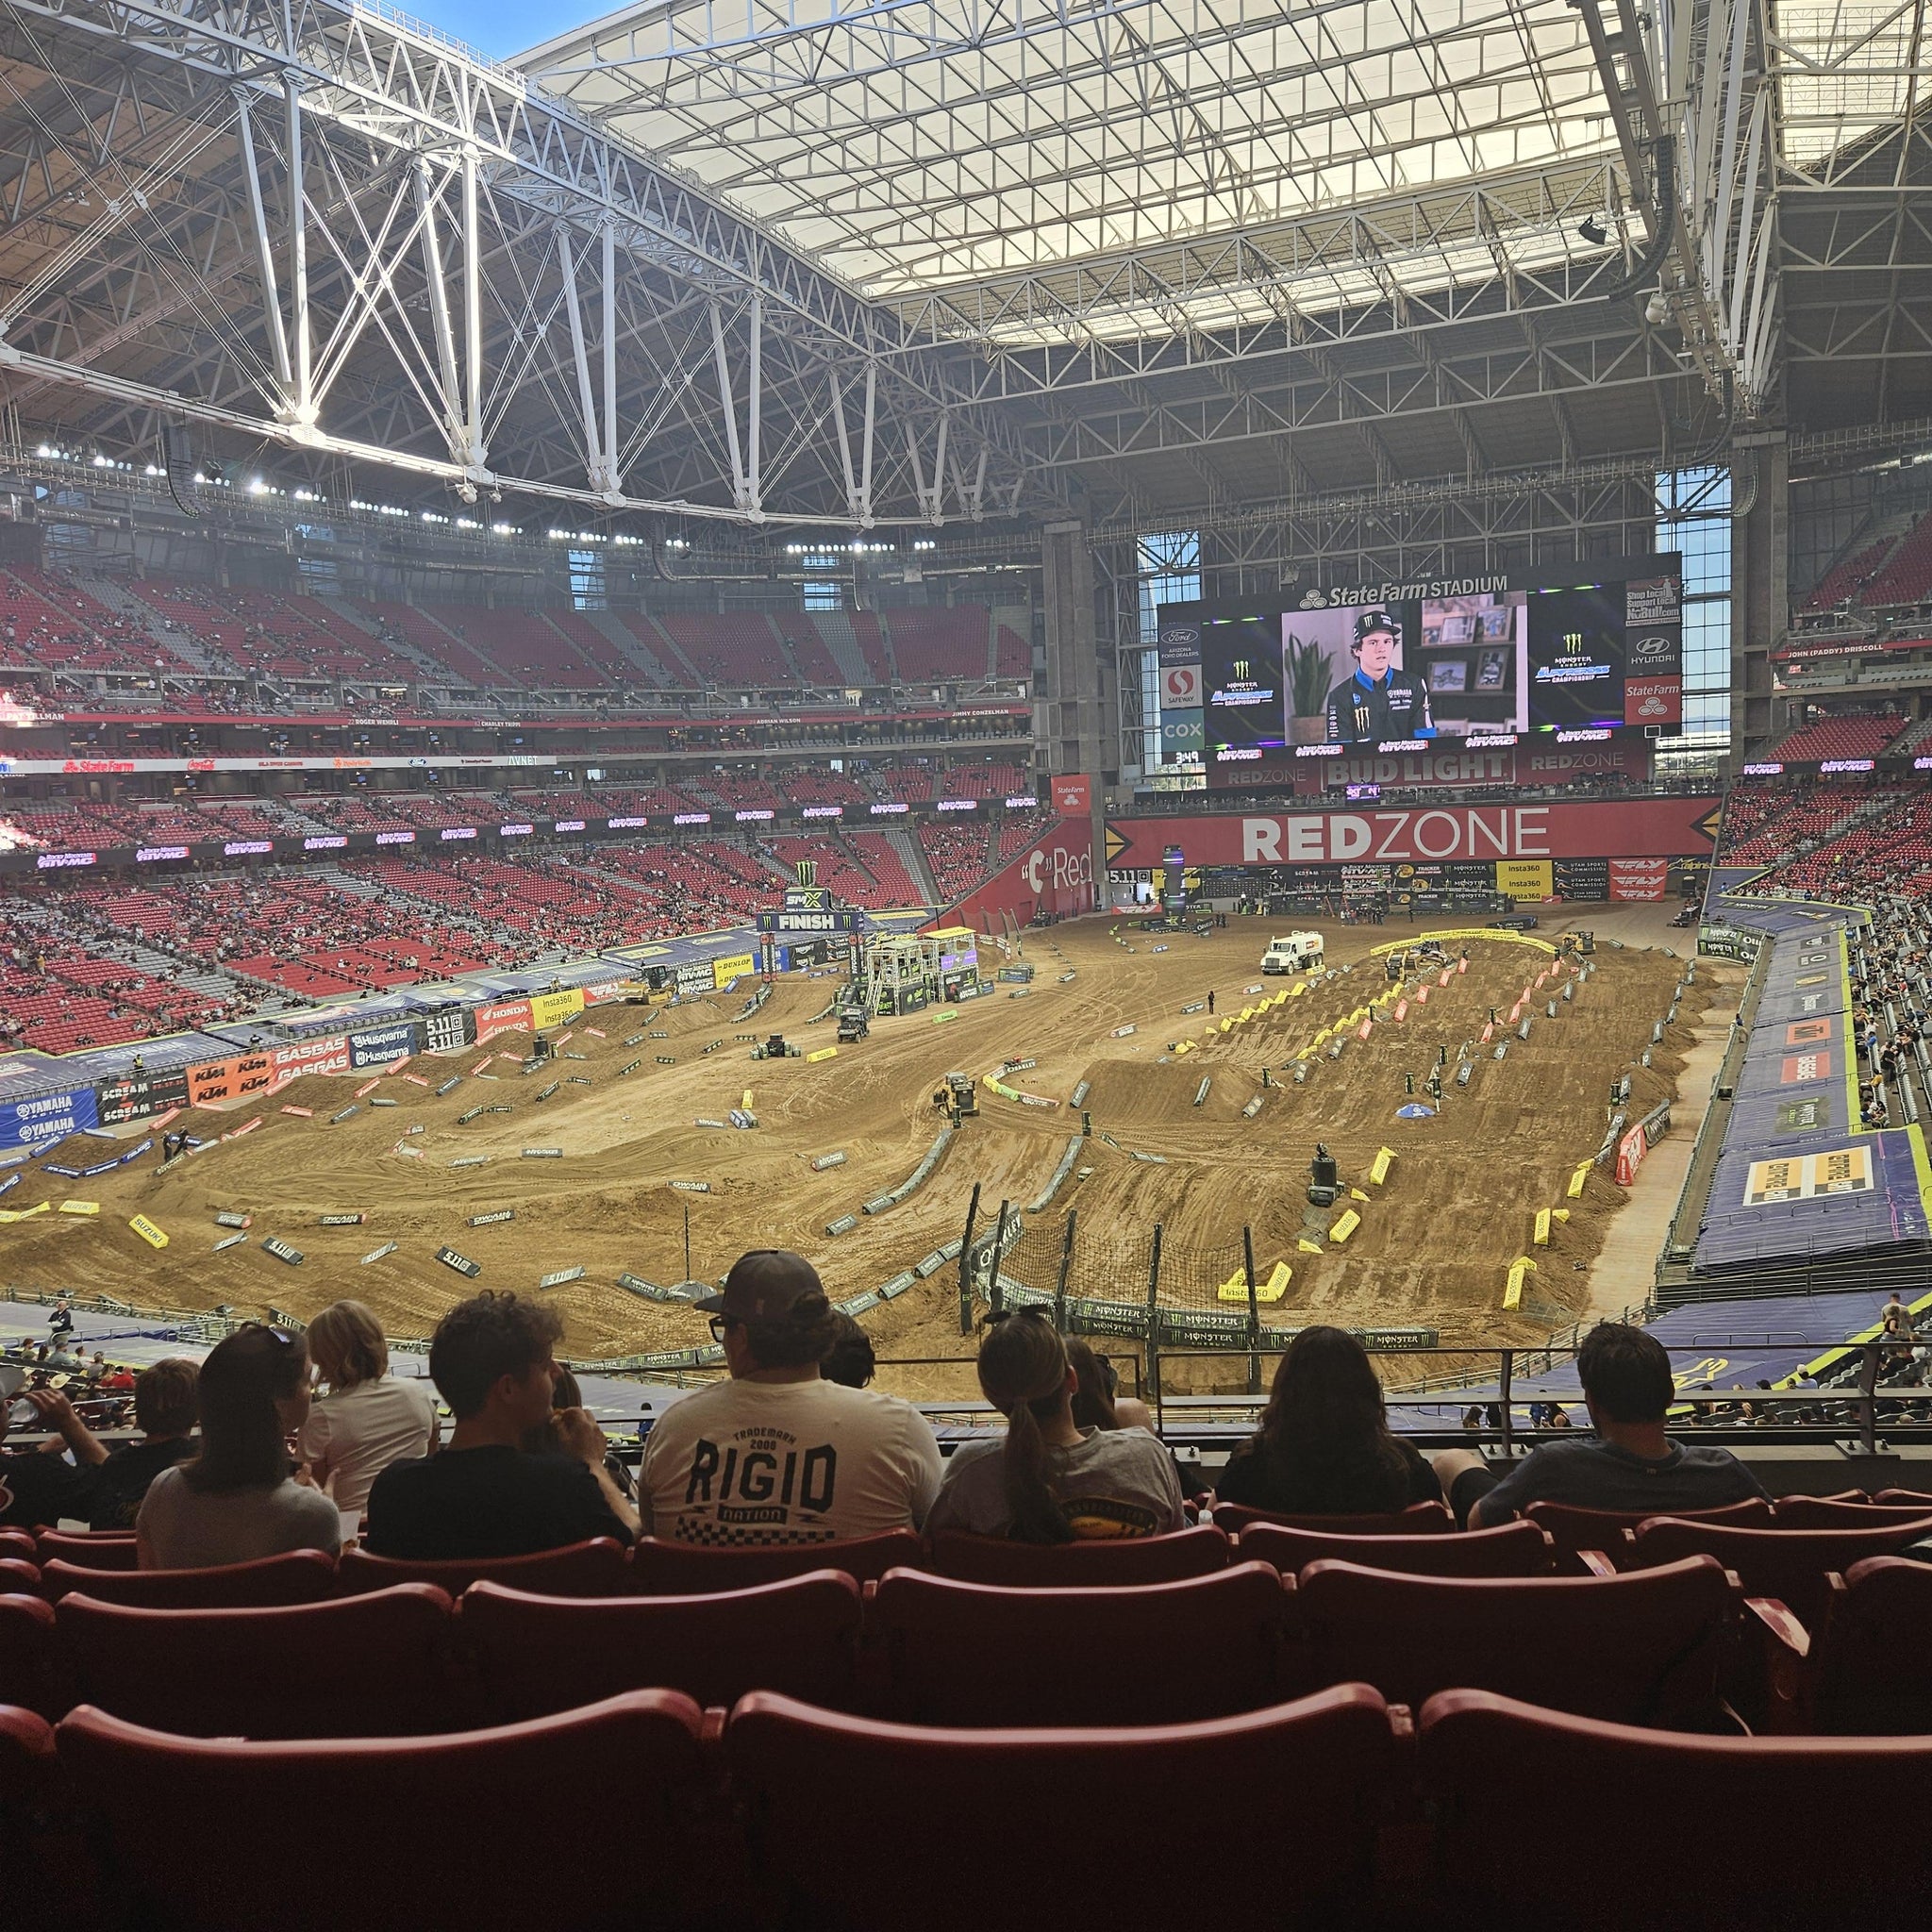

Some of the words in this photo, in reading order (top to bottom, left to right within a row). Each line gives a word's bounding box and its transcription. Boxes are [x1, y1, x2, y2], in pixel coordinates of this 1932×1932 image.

[1430, 575, 1507, 597] STADIUM
[1626, 591, 1645, 600] Shop
[1646, 590, 1666, 598] Local
[1626, 598, 1656, 608] Support
[1657, 596, 1676, 605] Local
[1168, 631, 1191, 642] Ford
[1788, 650, 1808, 658] JOHN
[1809, 647, 1843, 658] (PADDY)
[1844, 643, 1884, 654] DRISCOLL
[1555, 657, 1591, 665] MONSTER
[1631, 654, 1674, 664] HYUNDAI
[1552, 675, 1595, 683] CHAMPIONSHIP
[1164, 723, 1202, 739] COX
[508, 756, 538, 765] AVNET
[1175, 752, 1199, 763] 3:49
[1531, 752, 1624, 771] REDZONE
[1228, 768, 1307, 784] REDZONE
[1327, 757, 1398, 785] BUD
[1404, 753, 1508, 781] LIGHT
[1242, 808, 1550, 862] REDZONE
[1054, 843, 1091, 890] Red
[1508, 864, 1541, 873] Insta360
[1109, 870, 1137, 884] 5.11
[786, 891, 823, 908] SMX
[778, 915, 835, 929] FINISH
[723, 958, 751, 970] DUNLOP
[543, 994, 573, 1008] Insta360
[492, 1005, 528, 1019] HONDA
[426, 1016, 449, 1036] 5.11
[363, 1028, 408, 1046] Husqvarna
[428, 1034, 452, 1052] 5.11
[275, 1038, 346, 1064] GASGAS
[365, 1047, 409, 1062] Husqvarna
[238, 1058, 267, 1073] KTM
[1797, 1055, 1817, 1080] GASGAS
[194, 1066, 225, 1082] KTM
[240, 1075, 270, 1092] KTM
[102, 1083, 149, 1101] SCREAM
[196, 1085, 228, 1102] KTM
[29, 1095, 73, 1113] YAMAHA
[23, 1108, 71, 1121] RACING
[104, 1103, 151, 1122] SCREAM
[31, 1116, 75, 1135] YAMAHA
[1828, 1154, 1850, 1181] EMPIRE
[64, 1202, 92, 1211] SUZUKI
[134, 1217, 163, 1243] SUZUKI
[1336, 1214, 1355, 1236] Insta360
[270, 1239, 287, 1257] 5.11
[442, 1250, 463, 1267] 5.11
[631, 1277, 656, 1293] MONSTER
[1274, 1267, 1288, 1290] Insta360
[1226, 1289, 1268, 1297] Insta60
[1095, 1306, 1141, 1318] MONSTER
[1186, 1314, 1238, 1326] MONSTER
[276, 1314, 293, 1328] 5.11
[1093, 1321, 1133, 1333] MONSTER
[1184, 1331, 1233, 1342] MONSTER
[1376, 1335, 1418, 1344] MONSTER
[733, 1427, 797, 1444] TRADEMARK
[686, 1439, 837, 1513] RIGID
